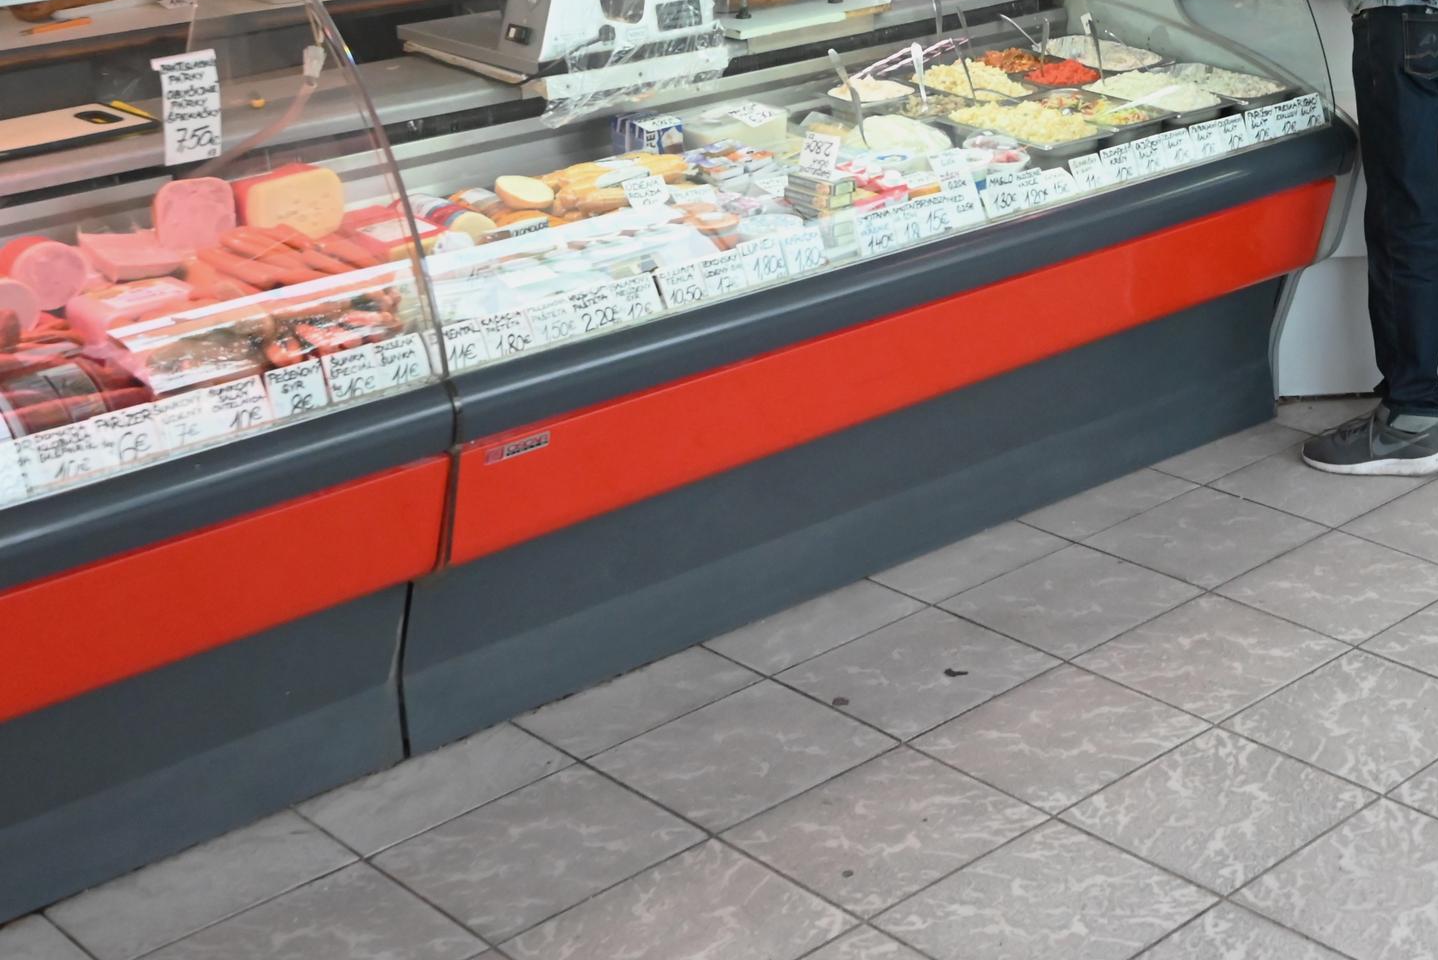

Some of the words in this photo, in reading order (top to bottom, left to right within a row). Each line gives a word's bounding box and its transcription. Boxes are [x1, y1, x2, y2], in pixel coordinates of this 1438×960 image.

[926, 208, 951, 231] 15€
[753, 254, 785, 280] 1,80€
[542, 321, 577, 340] 1,50€
[580, 305, 619, 334] 2,20€
[449, 343, 478, 361] 11€
[496, 333, 532, 355] 1,80€
[392, 363, 420, 382] 11€
[230, 409, 262, 429] 10€
[119, 431, 152, 461] 6€
